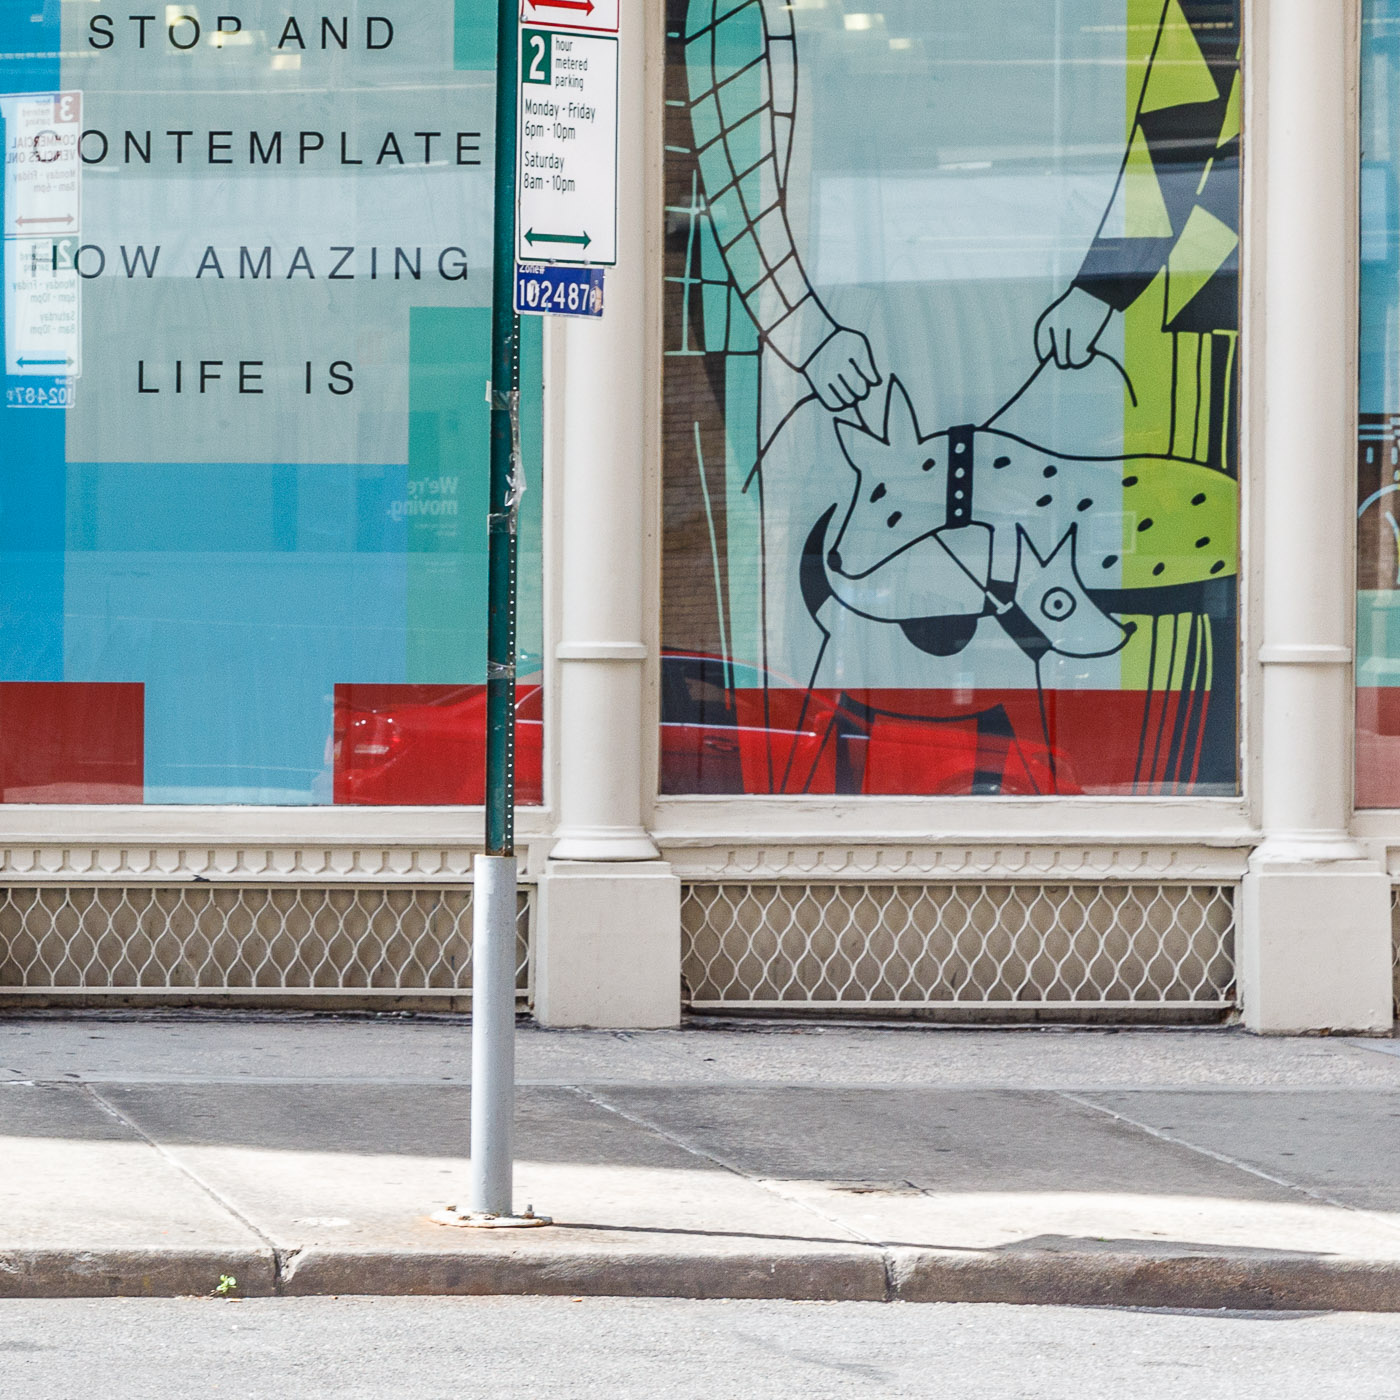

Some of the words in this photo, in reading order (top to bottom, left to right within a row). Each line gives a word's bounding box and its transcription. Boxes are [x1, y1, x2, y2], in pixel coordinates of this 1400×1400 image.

[88, 15, 244, 50] STOP
[278, 16, 395, 50] AND
[556, 37, 573, 52] hour
[529, 35, 546, 80] 2
[555, 55, 588, 72] metered
[555, 73, 584, 92] parking
[525, 98, 560, 120] Monday
[568, 101, 596, 123] Friday
[525, 121, 544, 139] 6pm
[553, 122, 576, 143] 10pm
[33, 130, 482, 165] CONTEMPLATE
[524, 151, 565, 173] Saturday
[524, 173, 543, 190] 8am
[552, 174, 576, 195] 10pm
[31, 245, 160, 280] HOW
[196, 246, 469, 281] AMAZING
[519, 279, 590, 311] 102487
[138, 360, 263, 394] LIFE
[306, 360, 355, 395] IS
